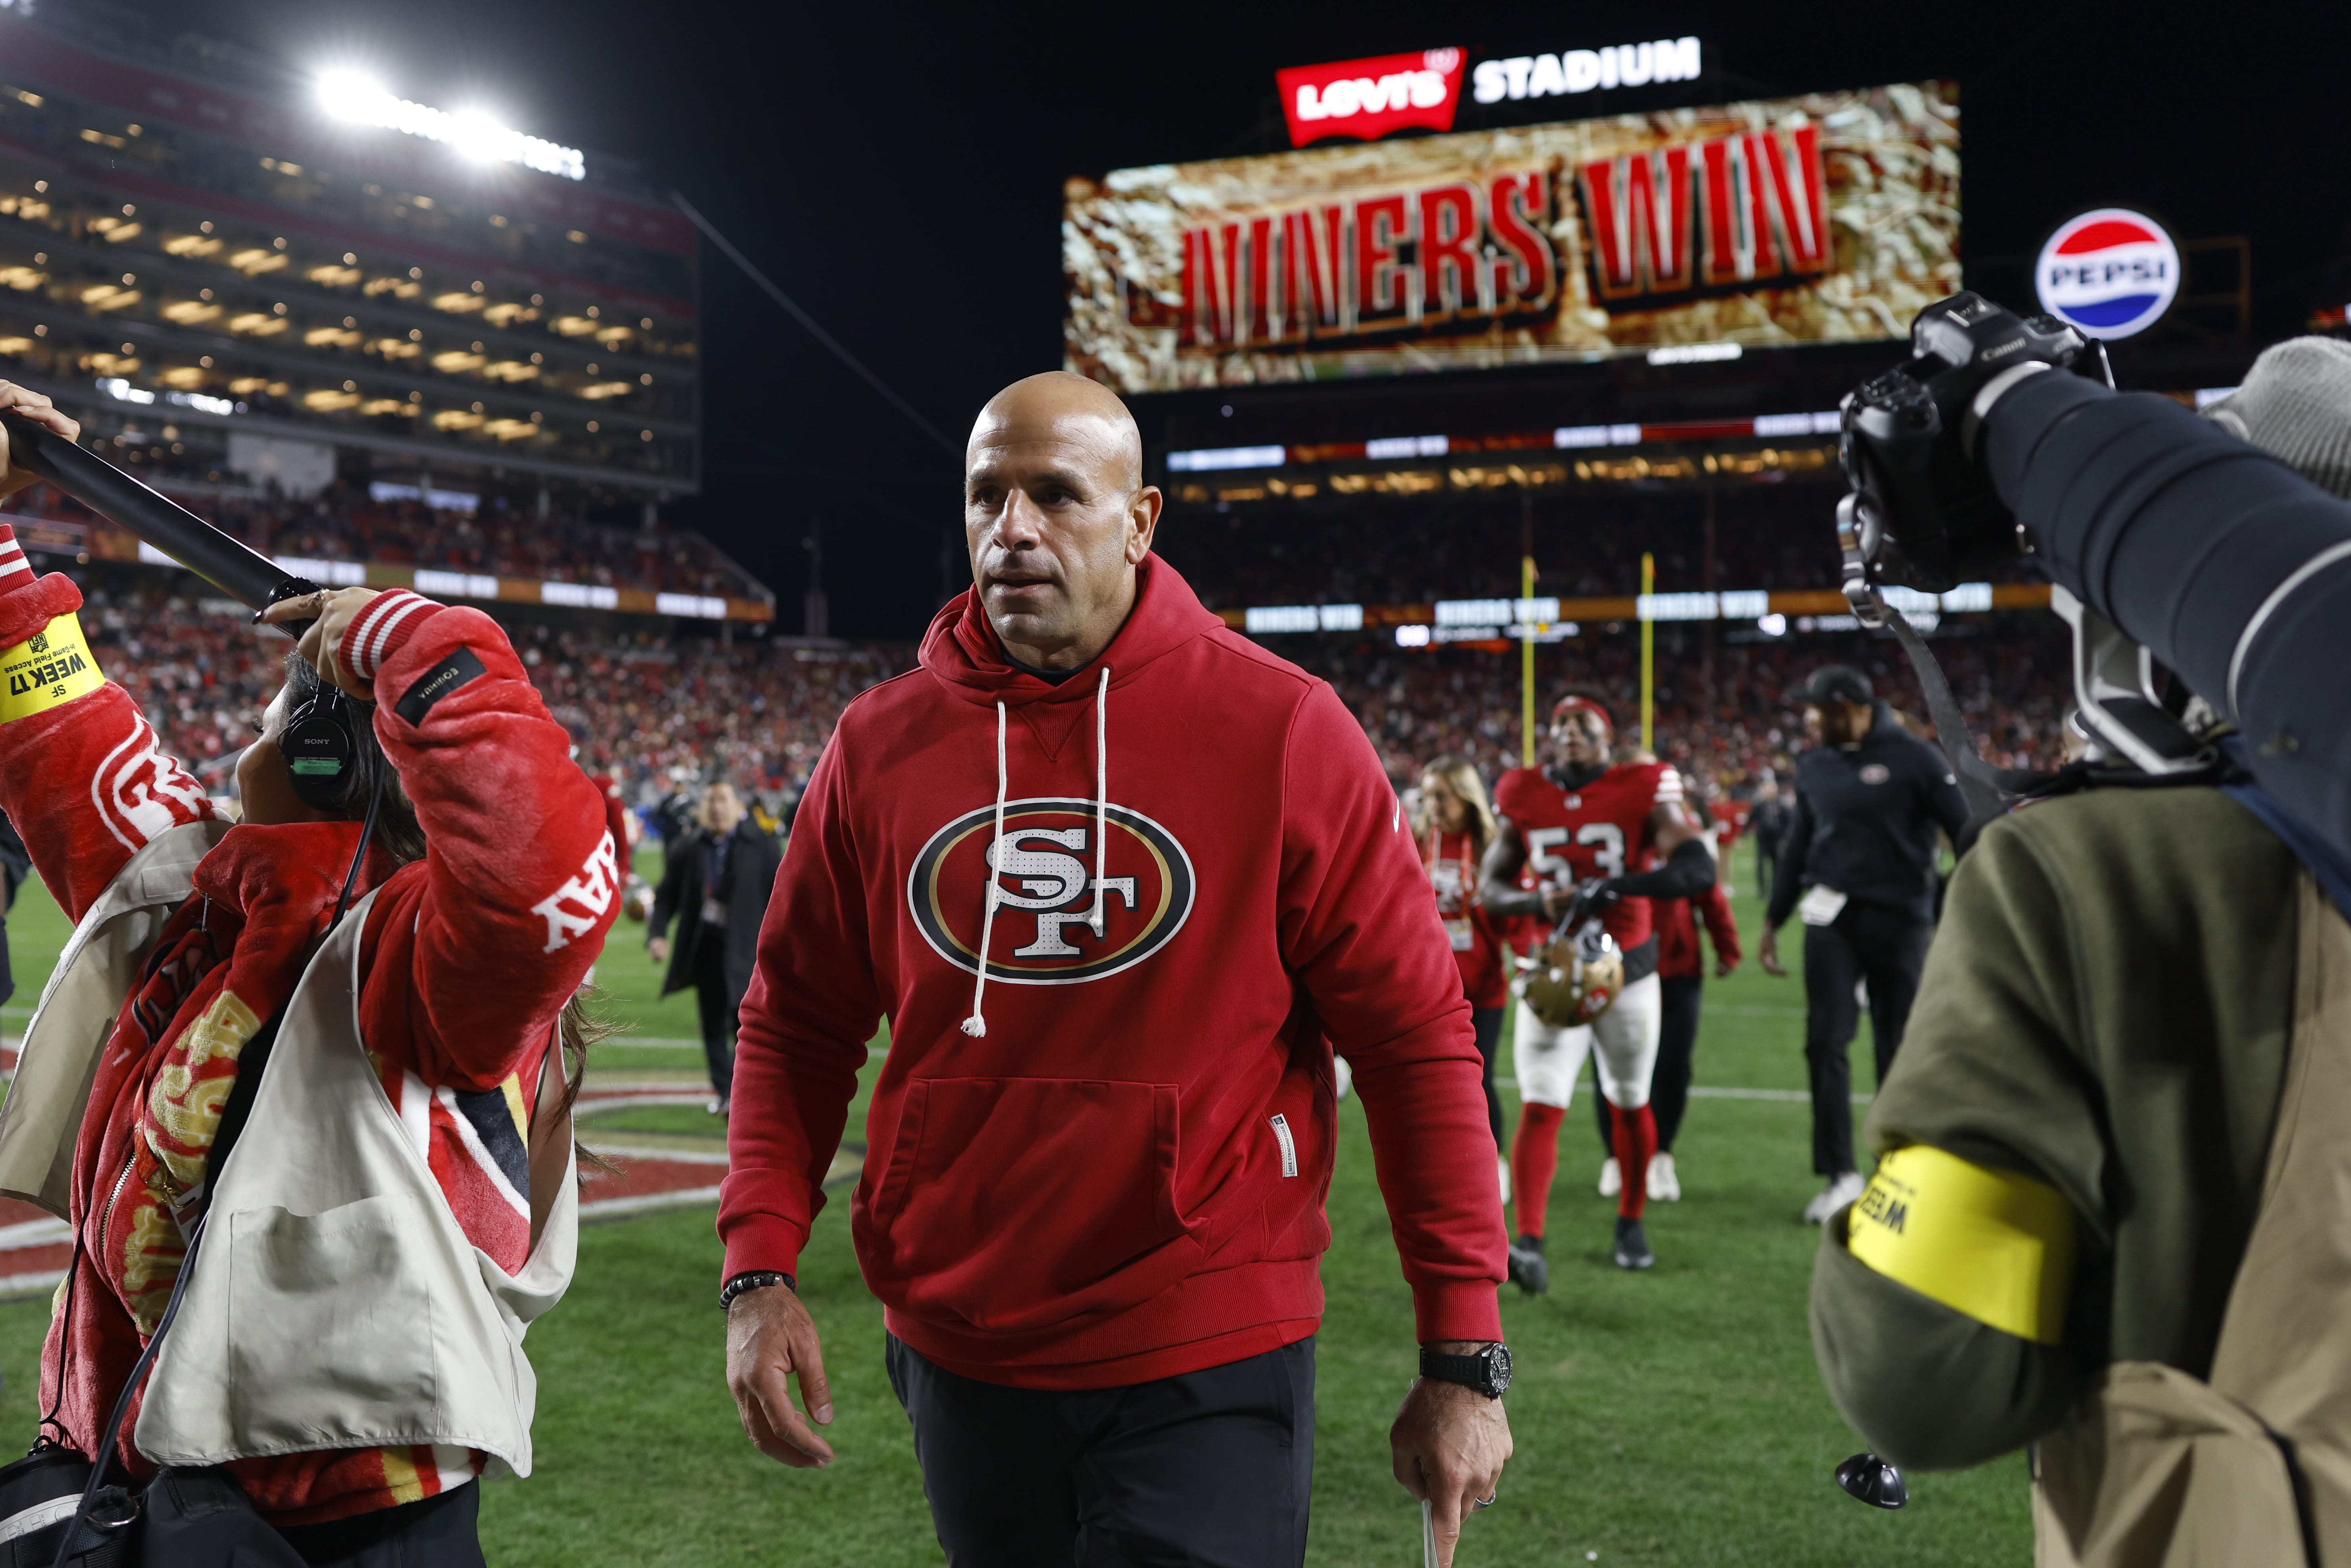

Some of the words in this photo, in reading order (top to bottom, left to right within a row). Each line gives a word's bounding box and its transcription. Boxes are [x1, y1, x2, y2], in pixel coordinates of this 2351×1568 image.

[1473, 36, 1701, 104] STADIUM
[1181, 169, 1554, 346] NINERS
[1582, 126, 1830, 298] WIN
[2051, 259, 2165, 287] PEPSI
[1980, 337, 2026, 361] Canon
[34, 654, 52, 664] Field
[53, 644, 75, 656] In-Game
[4, 660, 31, 673] Access
[28, 653, 86, 688] WEEK
[10, 673, 31, 696] 17
[52, 685, 66, 698] SF
[1527, 823, 1625, 888] 53
[986, 829, 1134, 956] SF
